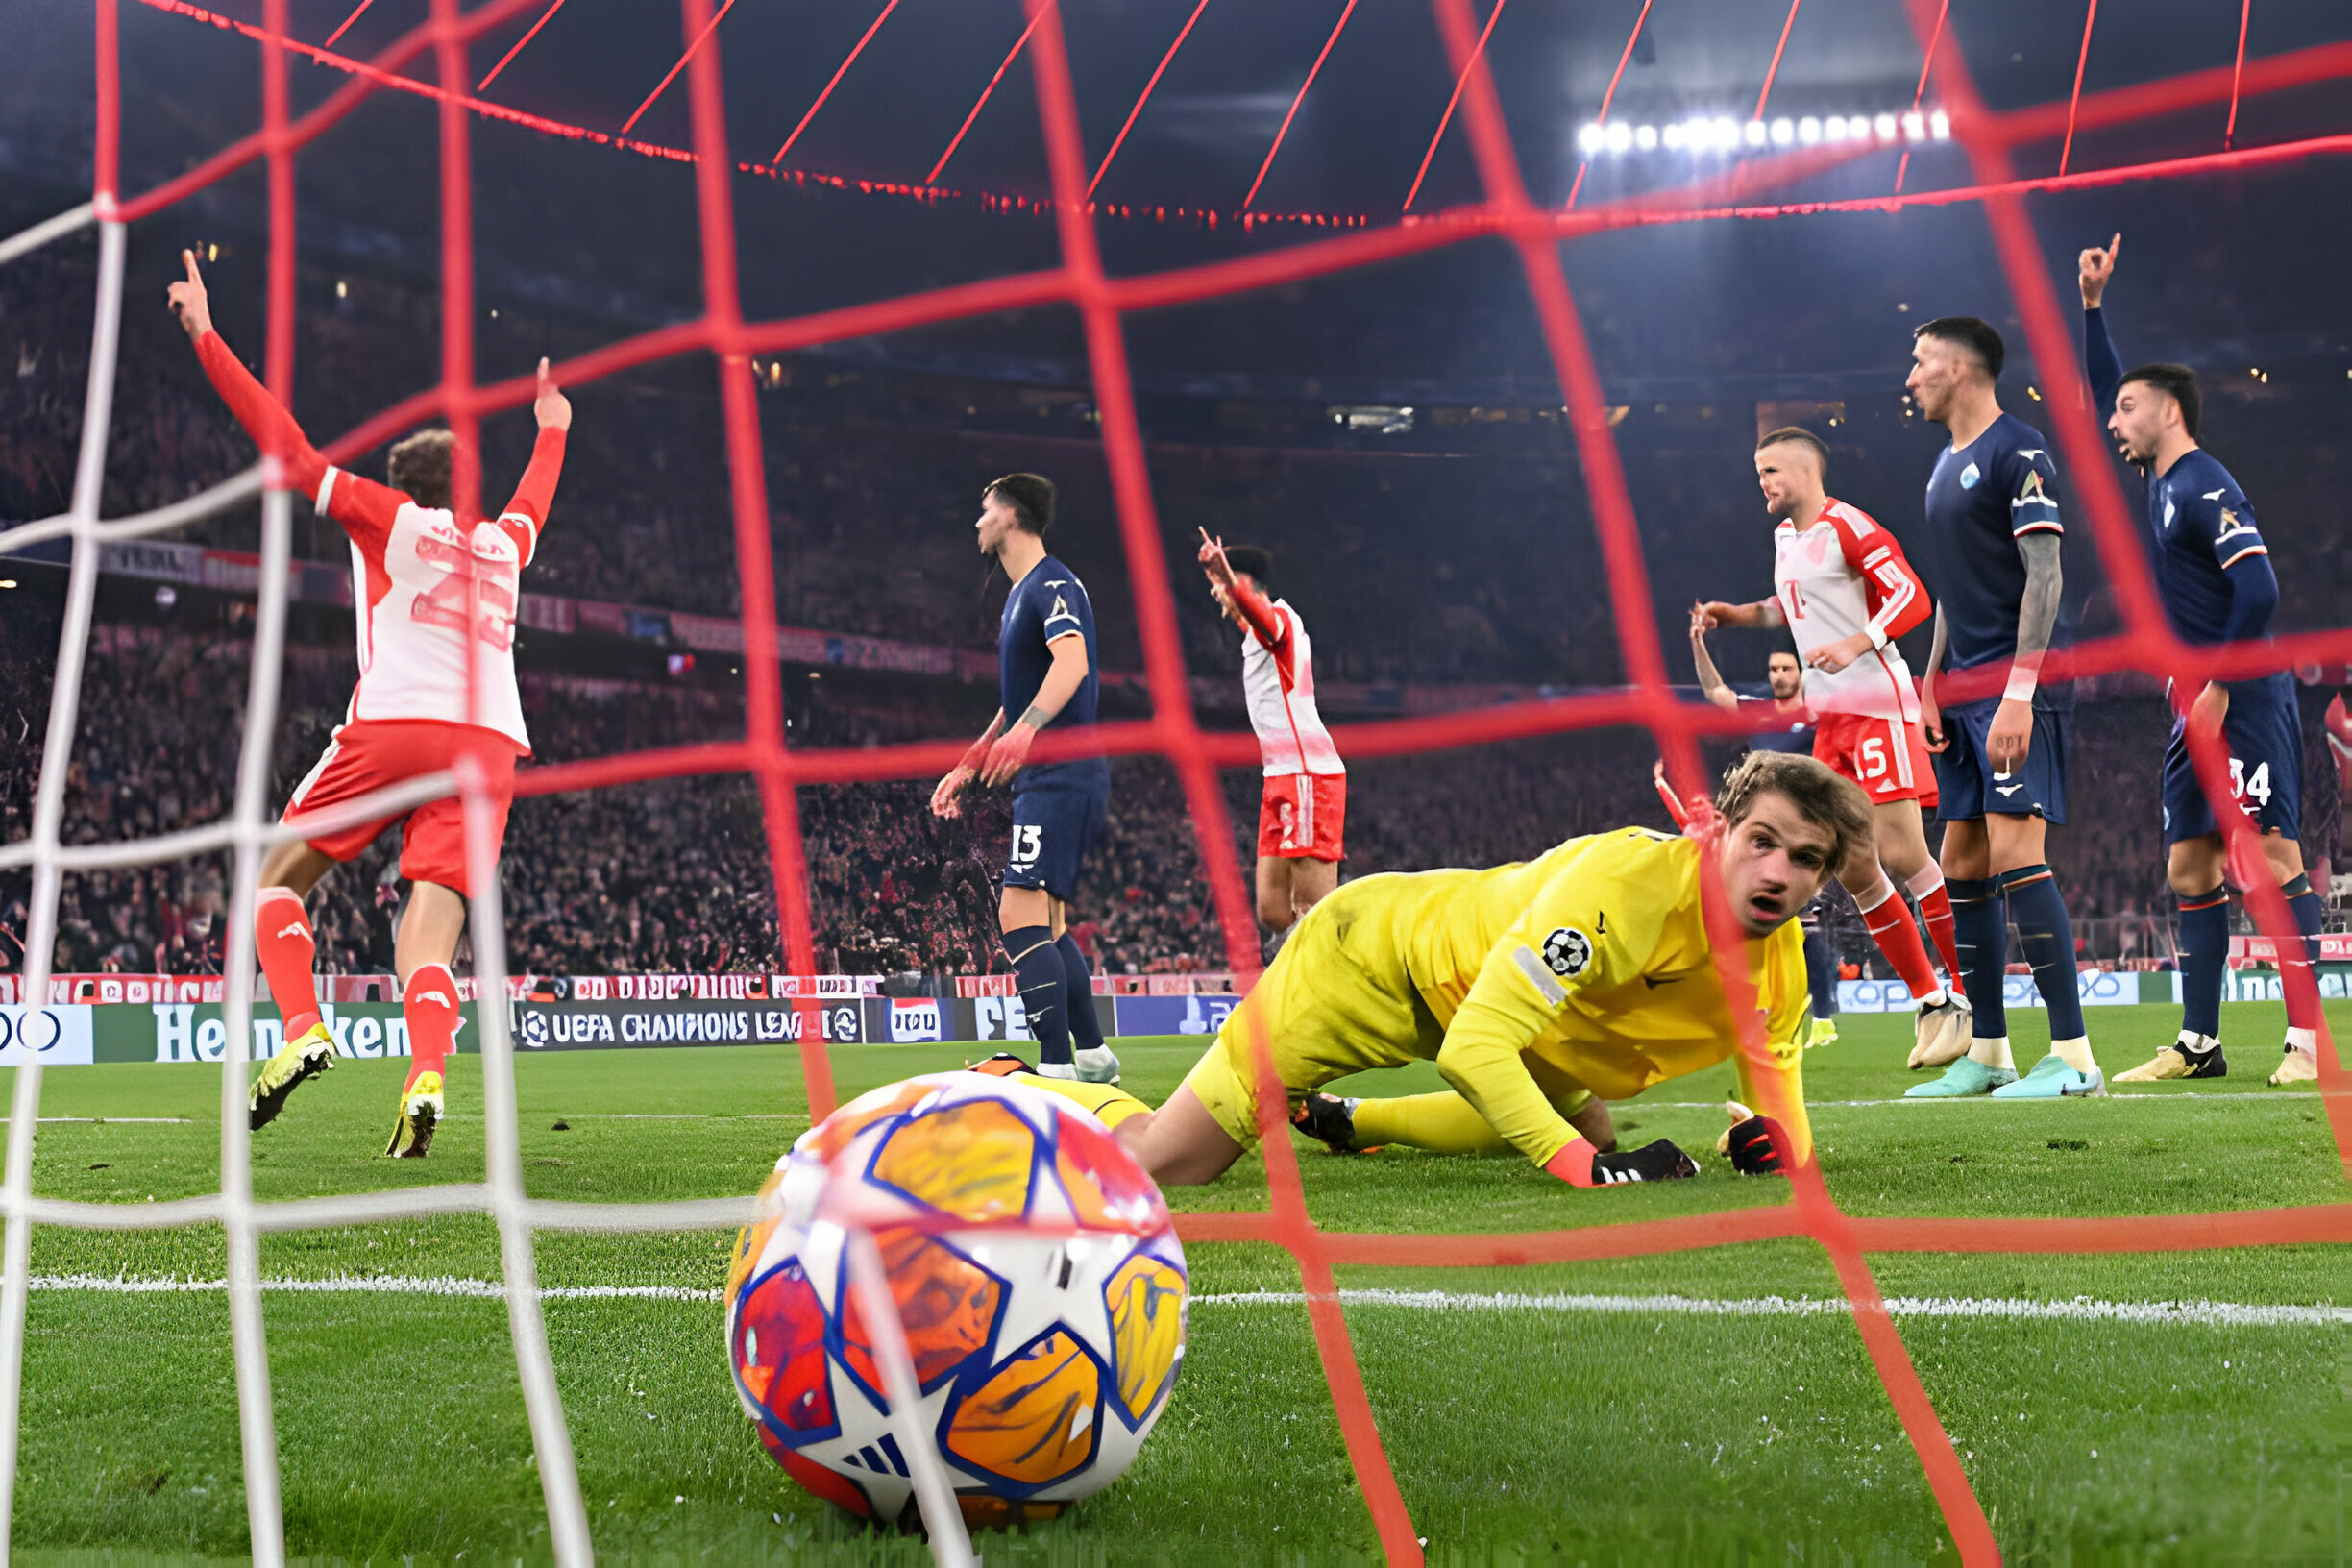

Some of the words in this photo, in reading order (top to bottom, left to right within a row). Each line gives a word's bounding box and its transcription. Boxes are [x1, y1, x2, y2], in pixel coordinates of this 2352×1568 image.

[1012, 824, 1041, 862] 13
[552, 1013, 615, 1042] UEFA
[621, 1011, 748, 1041] CHAMPIONS
